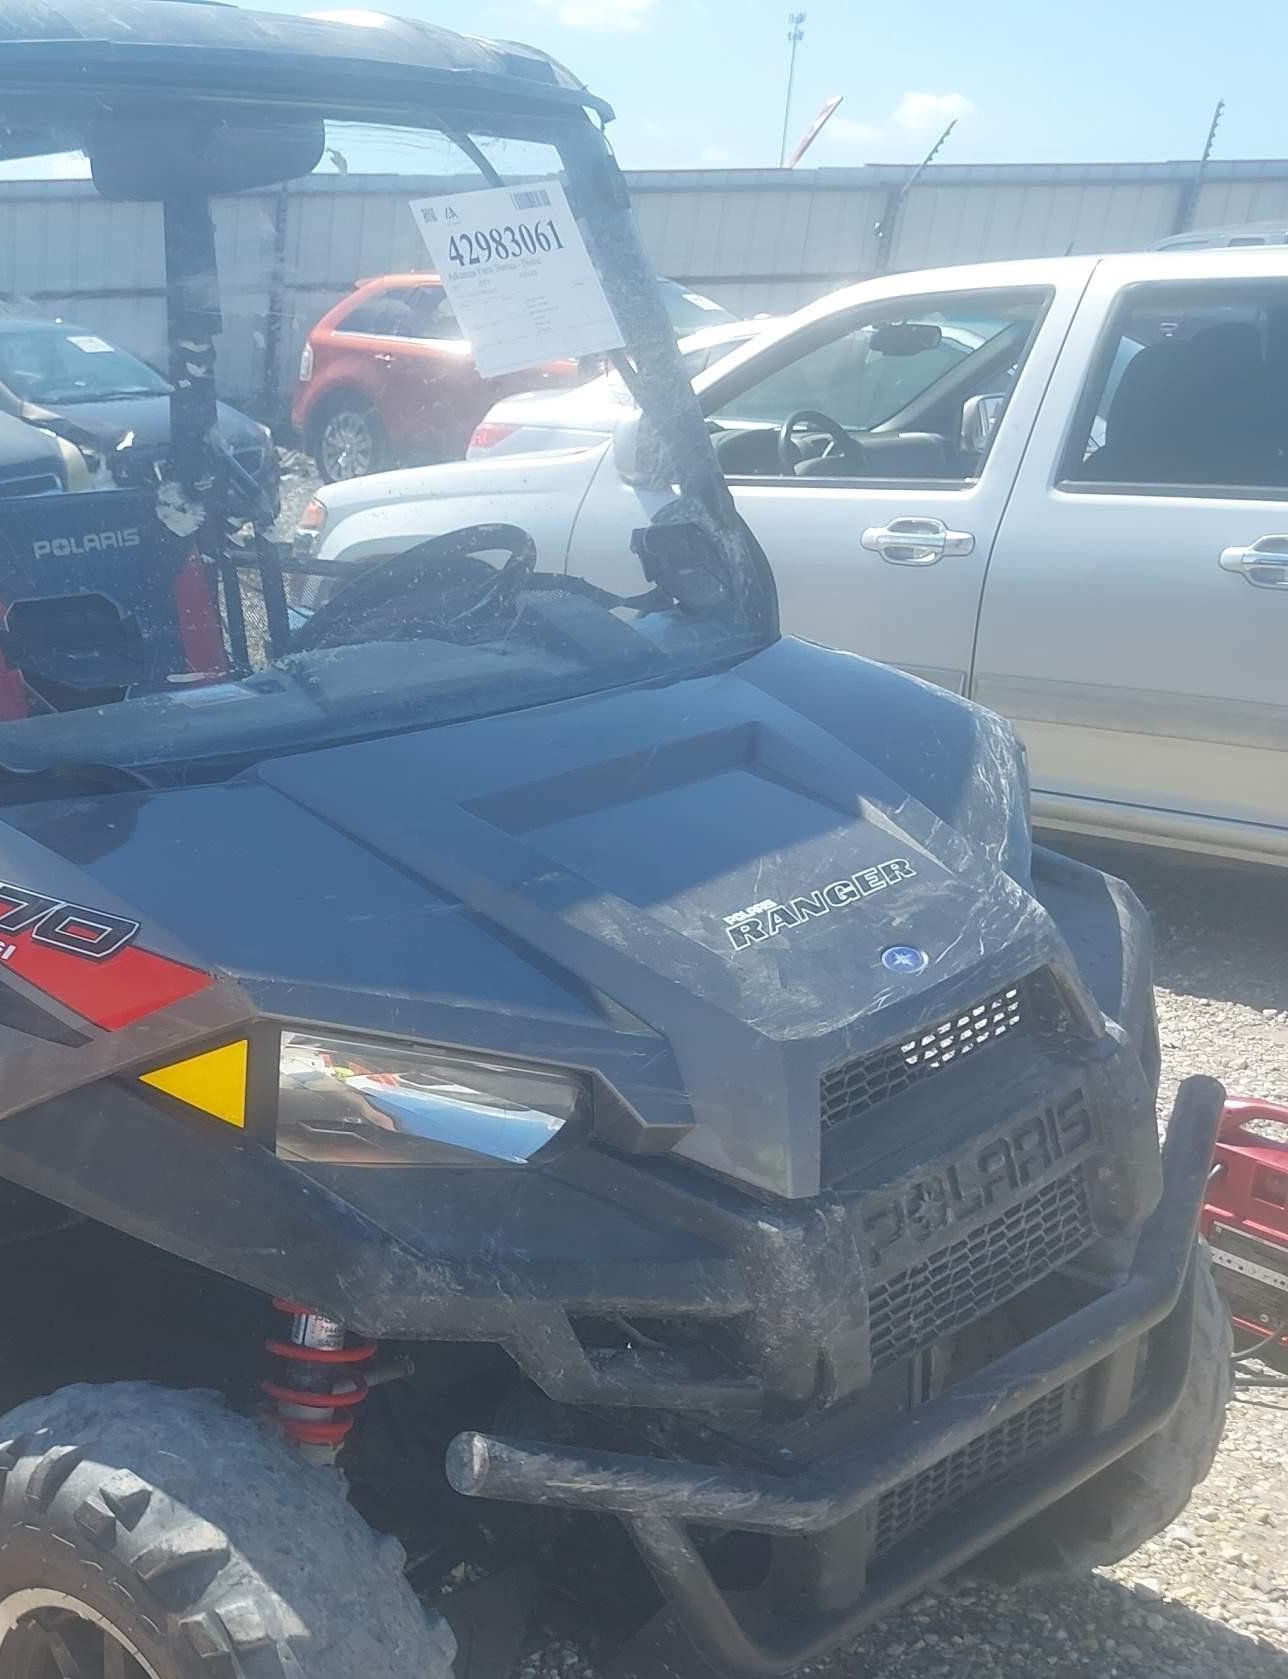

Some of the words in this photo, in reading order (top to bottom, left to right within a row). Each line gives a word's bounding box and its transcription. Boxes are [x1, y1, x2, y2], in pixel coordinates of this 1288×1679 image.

[449, 219, 564, 267] 42983061
[32, 528, 140, 559] POLARIS
[723, 899, 777, 925] POLARIS
[726, 858, 917, 951] RANGER
[863, 1087, 1091, 1268] POLARIS
